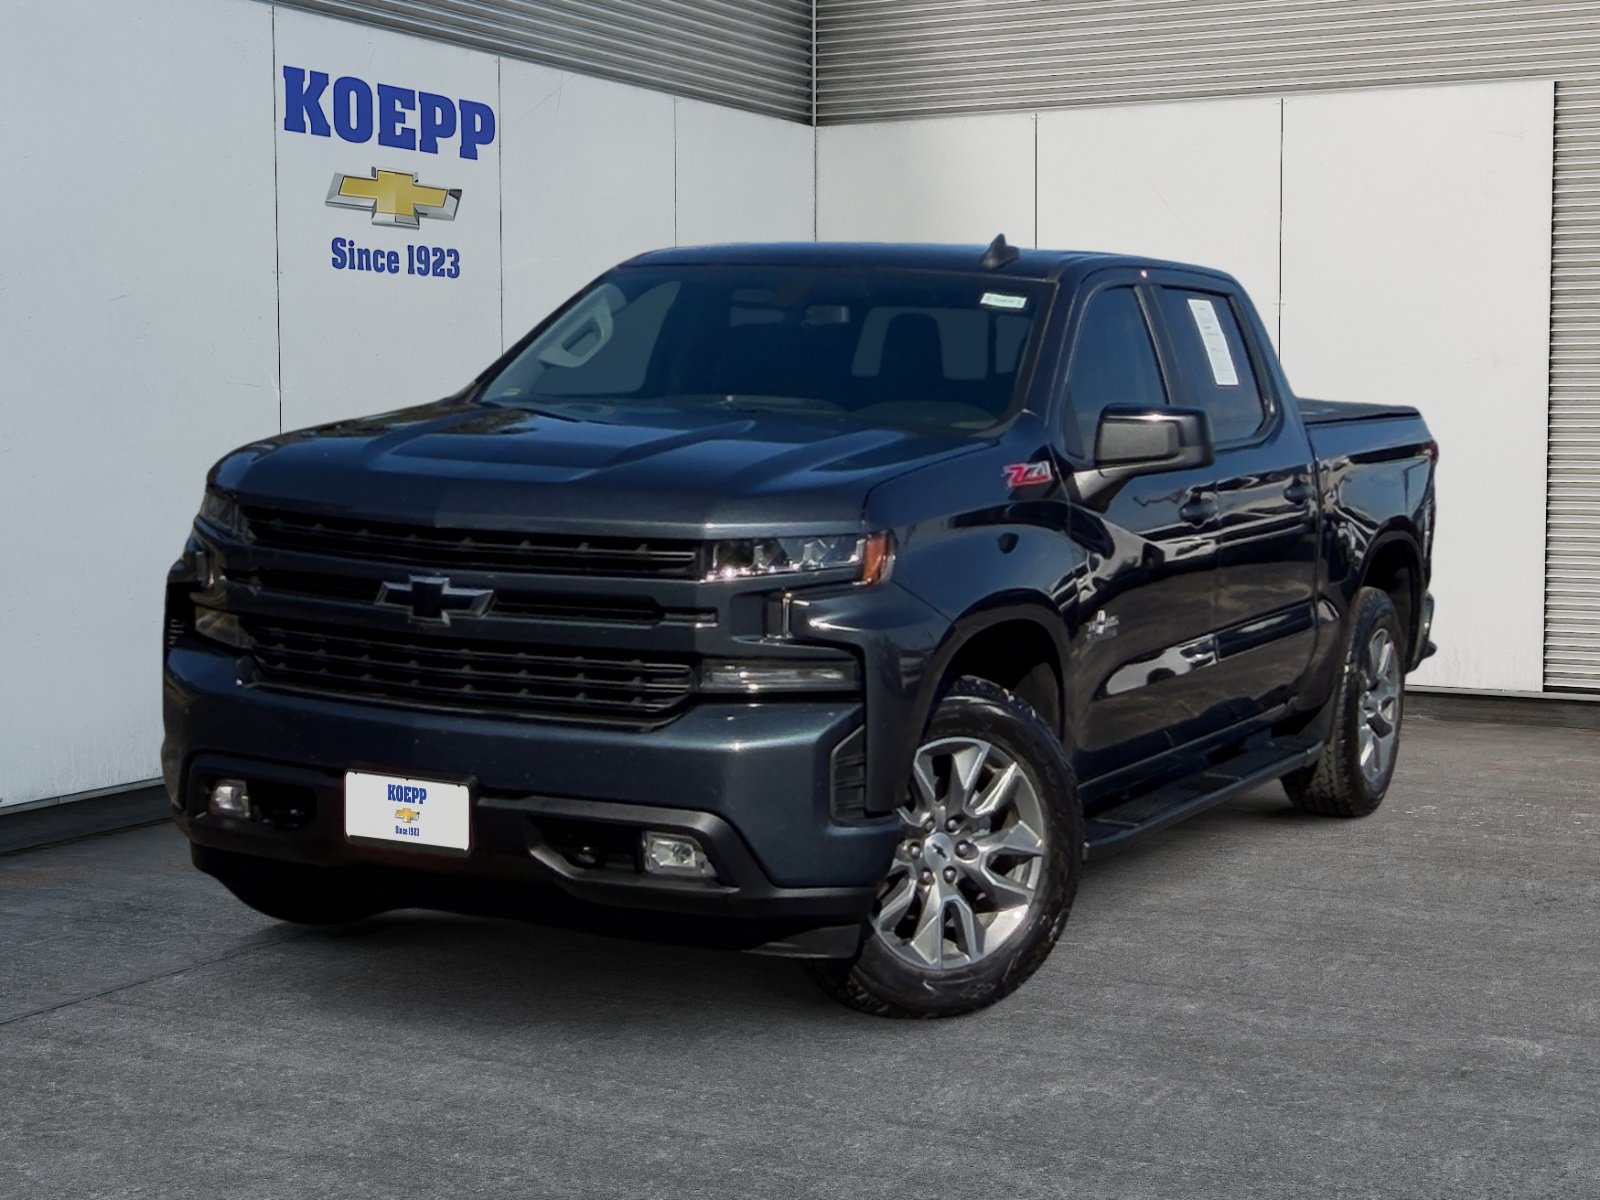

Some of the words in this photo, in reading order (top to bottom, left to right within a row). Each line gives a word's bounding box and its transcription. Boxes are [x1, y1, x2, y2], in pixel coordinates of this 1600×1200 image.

[283, 65, 496, 160] KOEPP
[331, 237, 400, 274] Since
[407, 244, 460, 279] 1923
[387, 784, 427, 804] KOEPP
